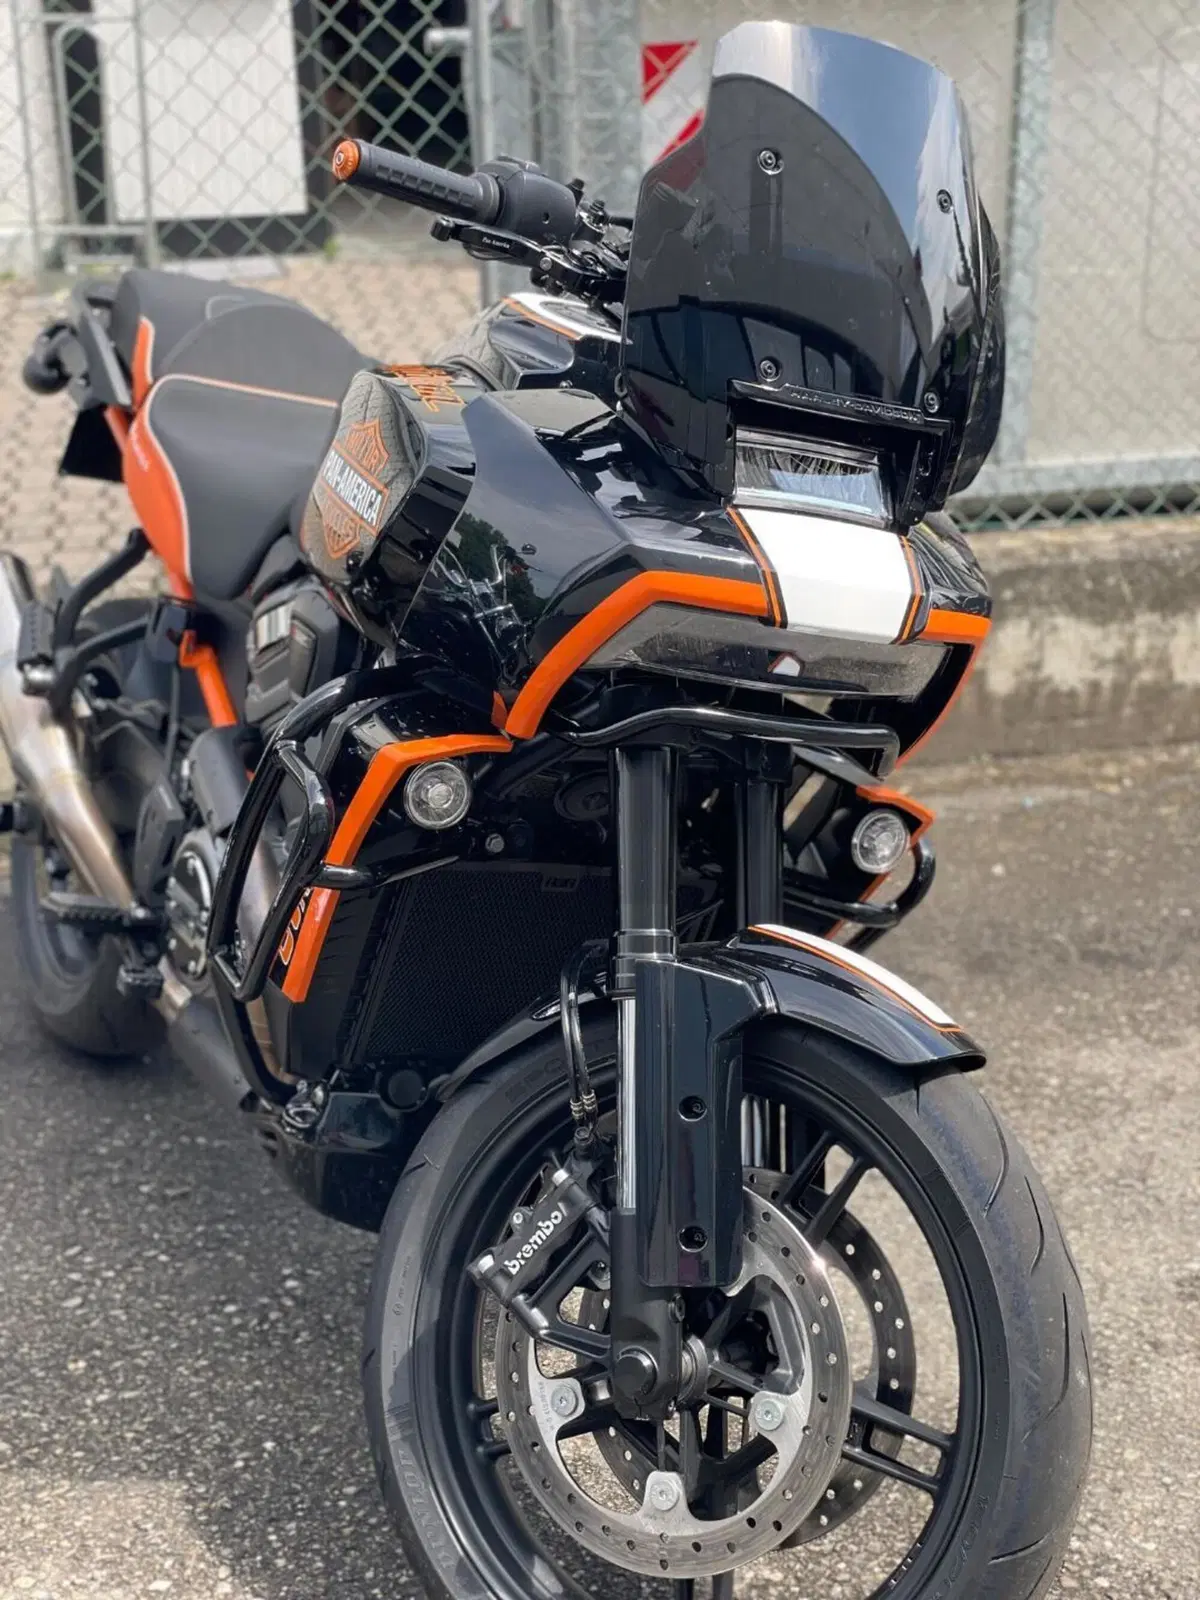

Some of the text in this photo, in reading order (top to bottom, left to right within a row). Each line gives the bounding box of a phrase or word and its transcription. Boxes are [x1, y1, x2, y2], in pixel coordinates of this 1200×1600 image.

[790, 391, 922, 424] HARLEY-DAVIDSON
[322, 449, 383, 527] PAN-AMERICA
[503, 1210, 563, 1275] brembo
